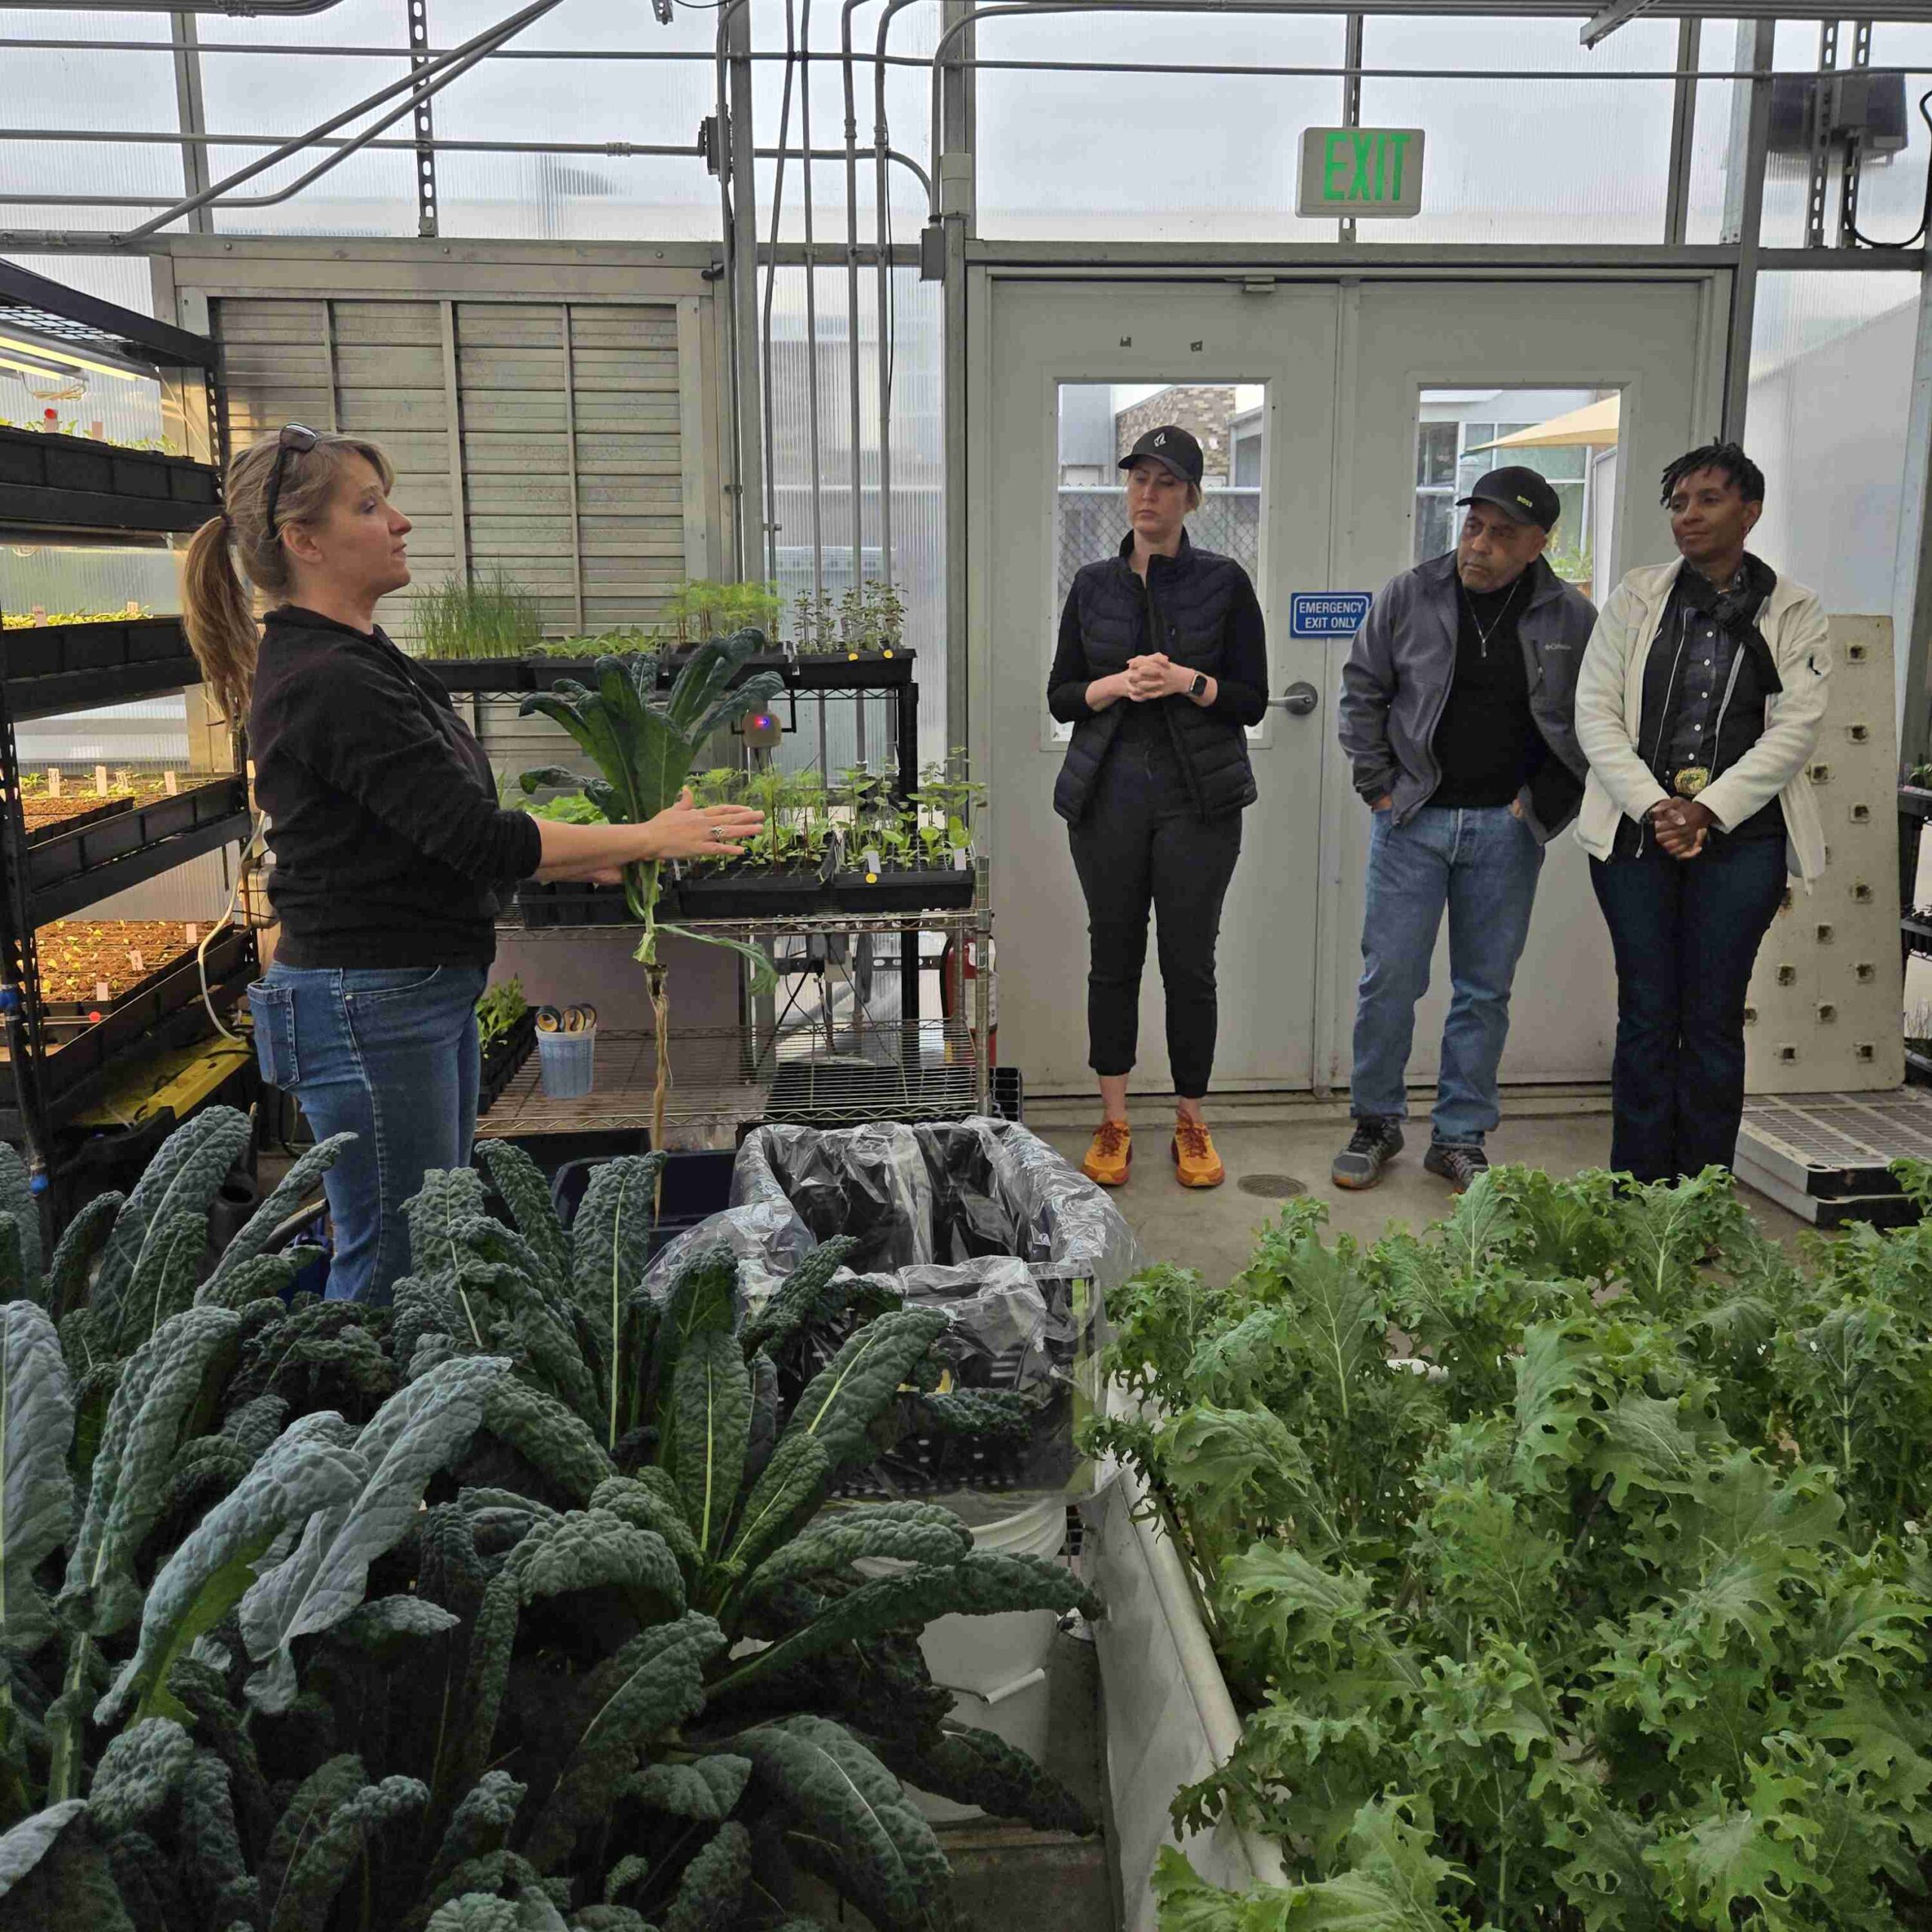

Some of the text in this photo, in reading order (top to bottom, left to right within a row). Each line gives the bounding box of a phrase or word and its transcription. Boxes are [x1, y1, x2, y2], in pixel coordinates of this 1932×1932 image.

[1324, 132, 1411, 201] EXIT
[1299, 601, 1364, 613] EMERGENCY
[1305, 617, 1357, 629] EXIT ONLY
